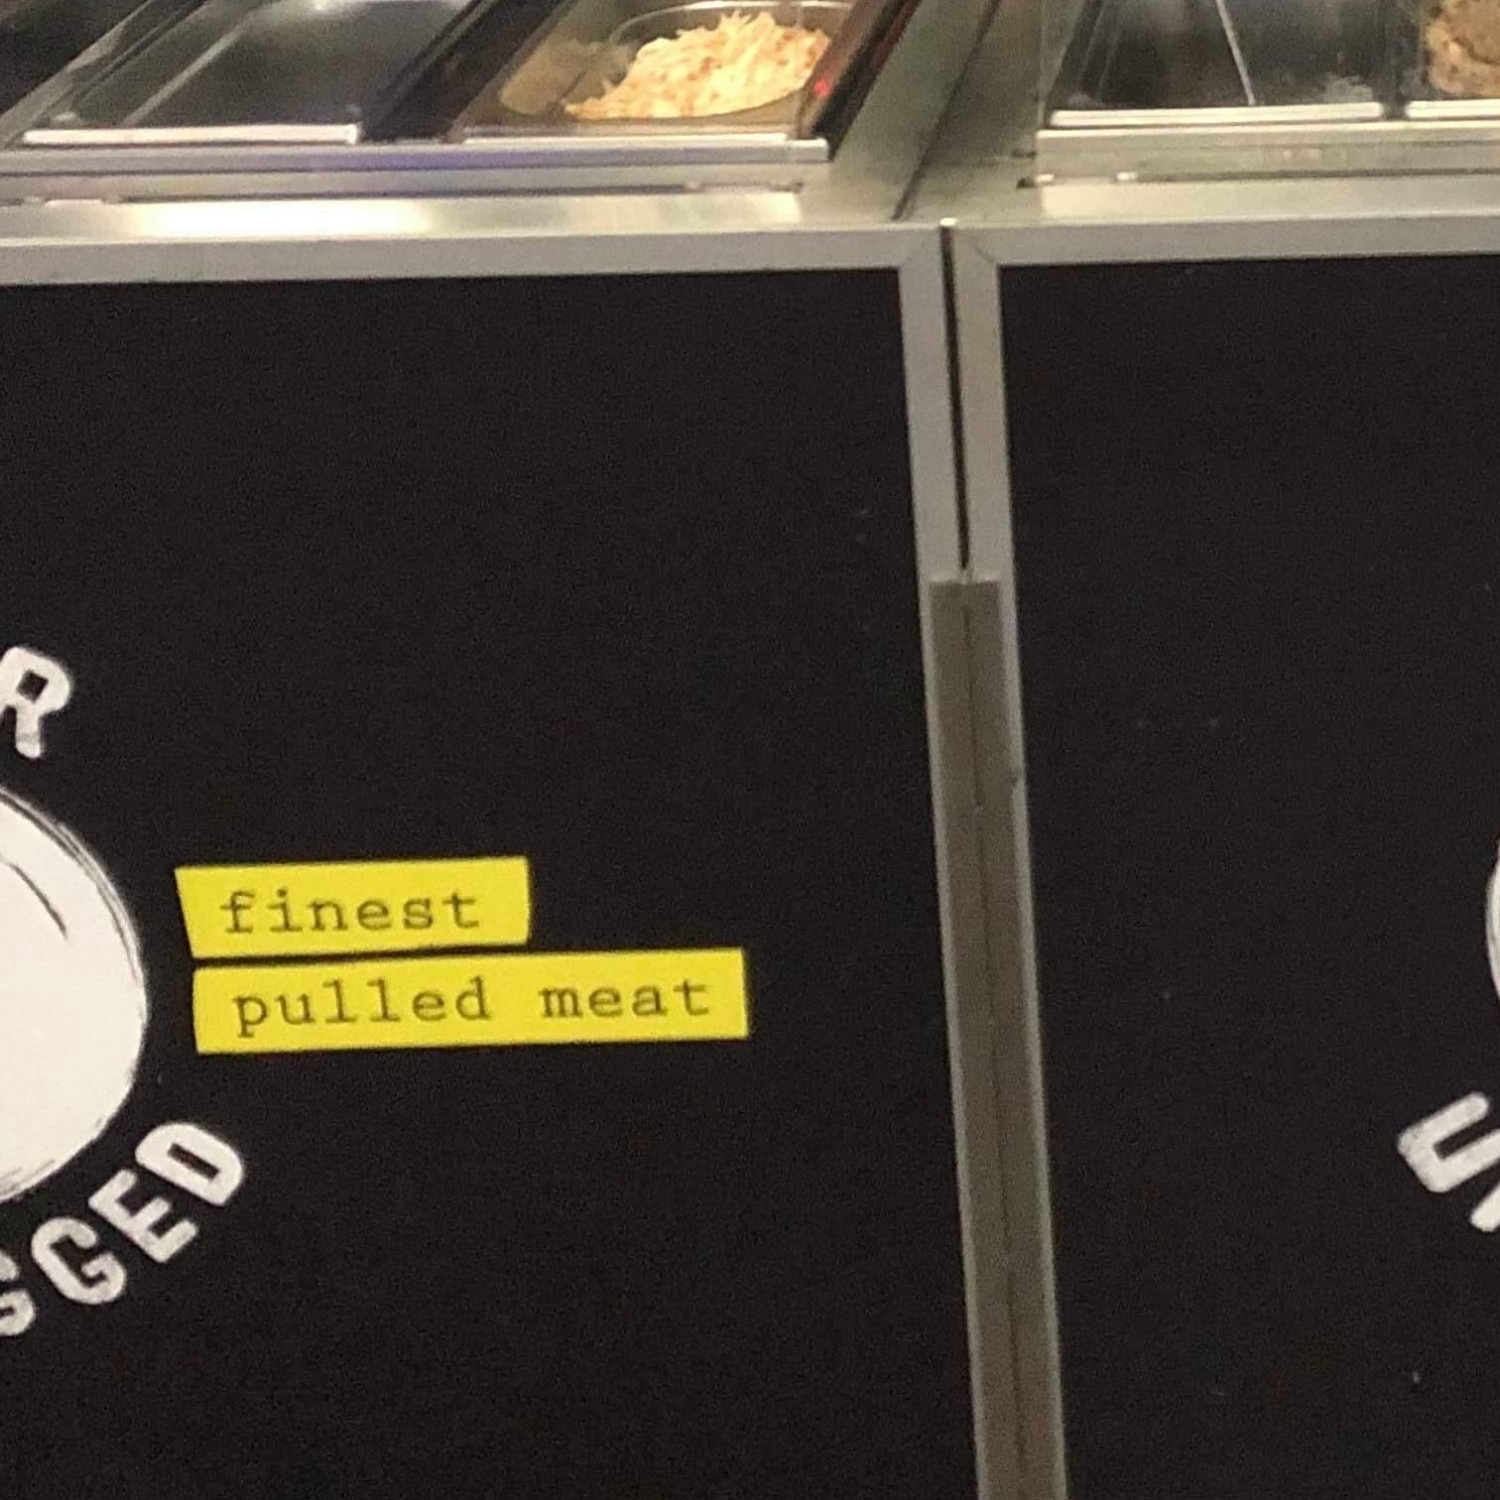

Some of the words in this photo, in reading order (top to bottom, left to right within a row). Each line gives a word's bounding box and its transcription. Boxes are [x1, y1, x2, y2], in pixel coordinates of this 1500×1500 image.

[221, 888, 482, 936] finest
[232, 975, 492, 1037] pulled
[539, 976, 713, 1021] meat
